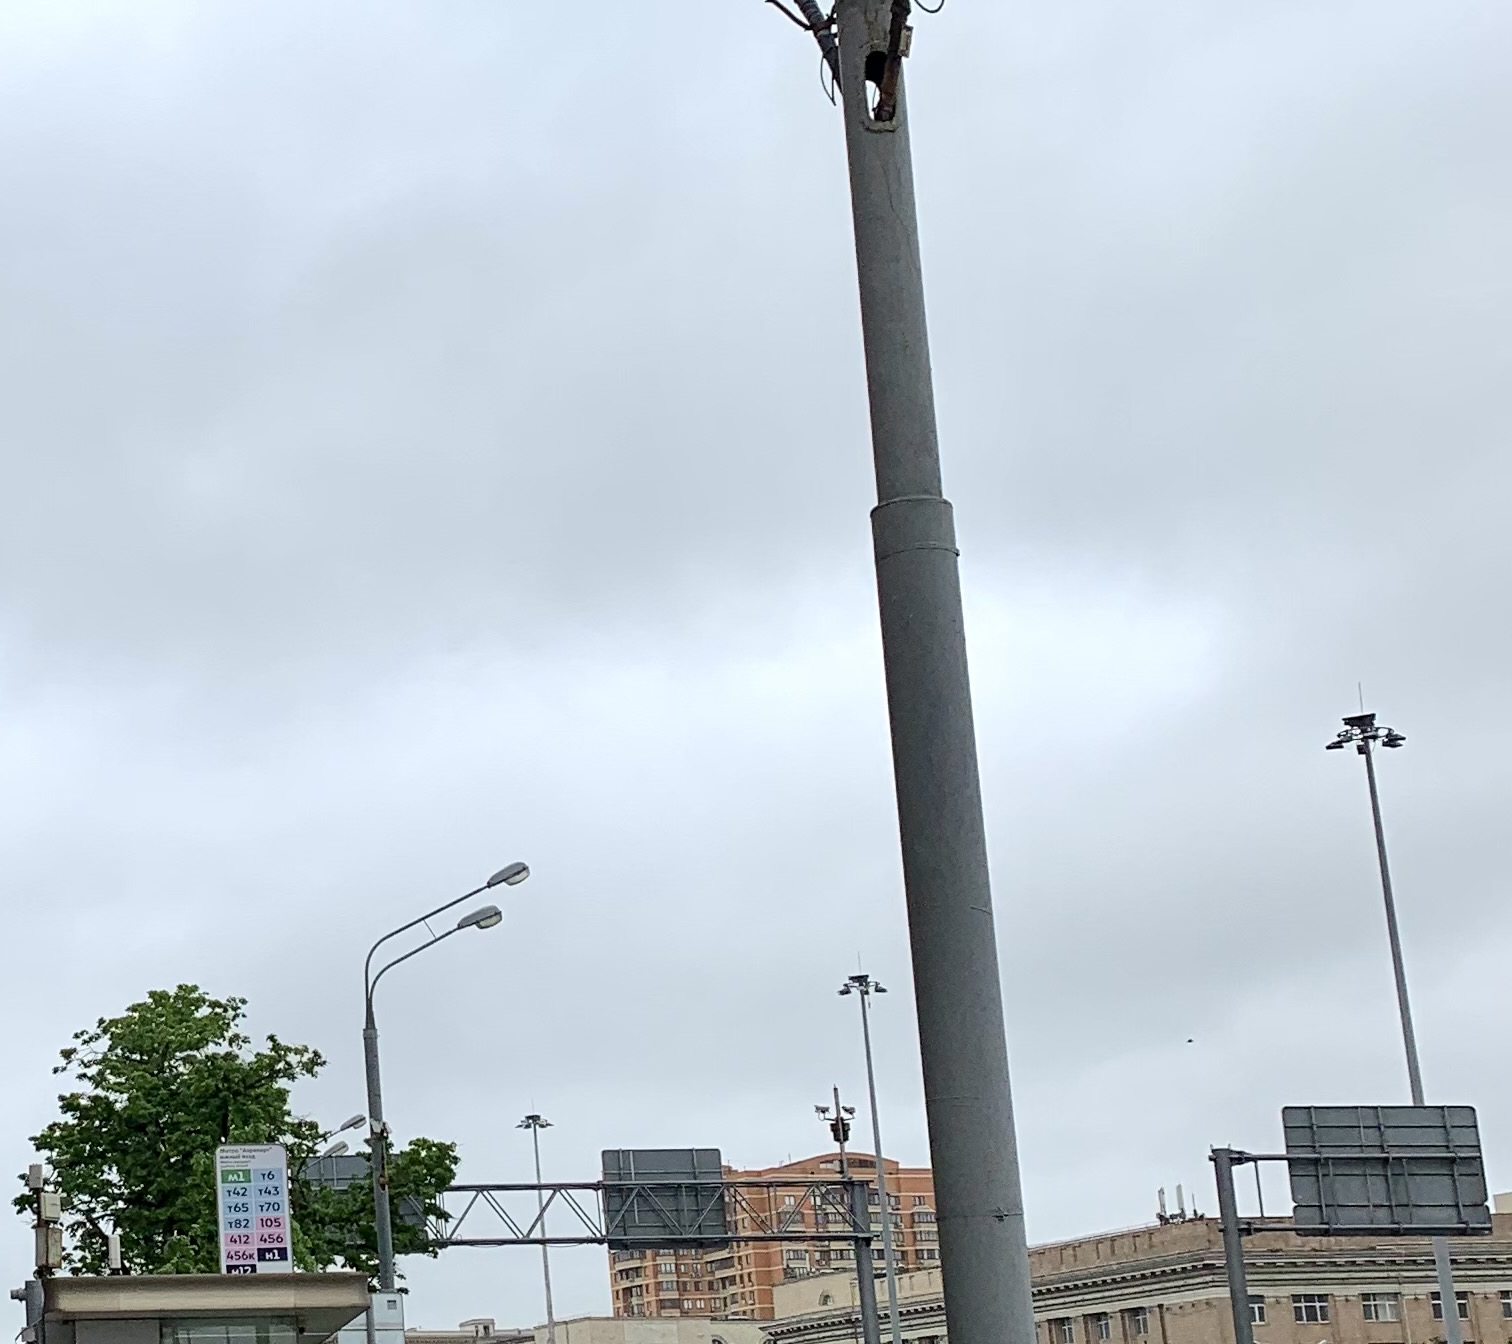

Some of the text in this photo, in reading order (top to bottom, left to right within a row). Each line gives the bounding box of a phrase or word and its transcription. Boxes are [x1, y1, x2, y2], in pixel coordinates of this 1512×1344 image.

[260, 1171, 275, 1181] т6
[226, 1186, 280, 1197] т42 т43
[228, 1202, 281, 1213] т65 т70
[228, 1218, 282, 1229] т82 105
[229, 1234, 284, 1244] 412 456
[226, 1249, 281, 1261] 456к н1
